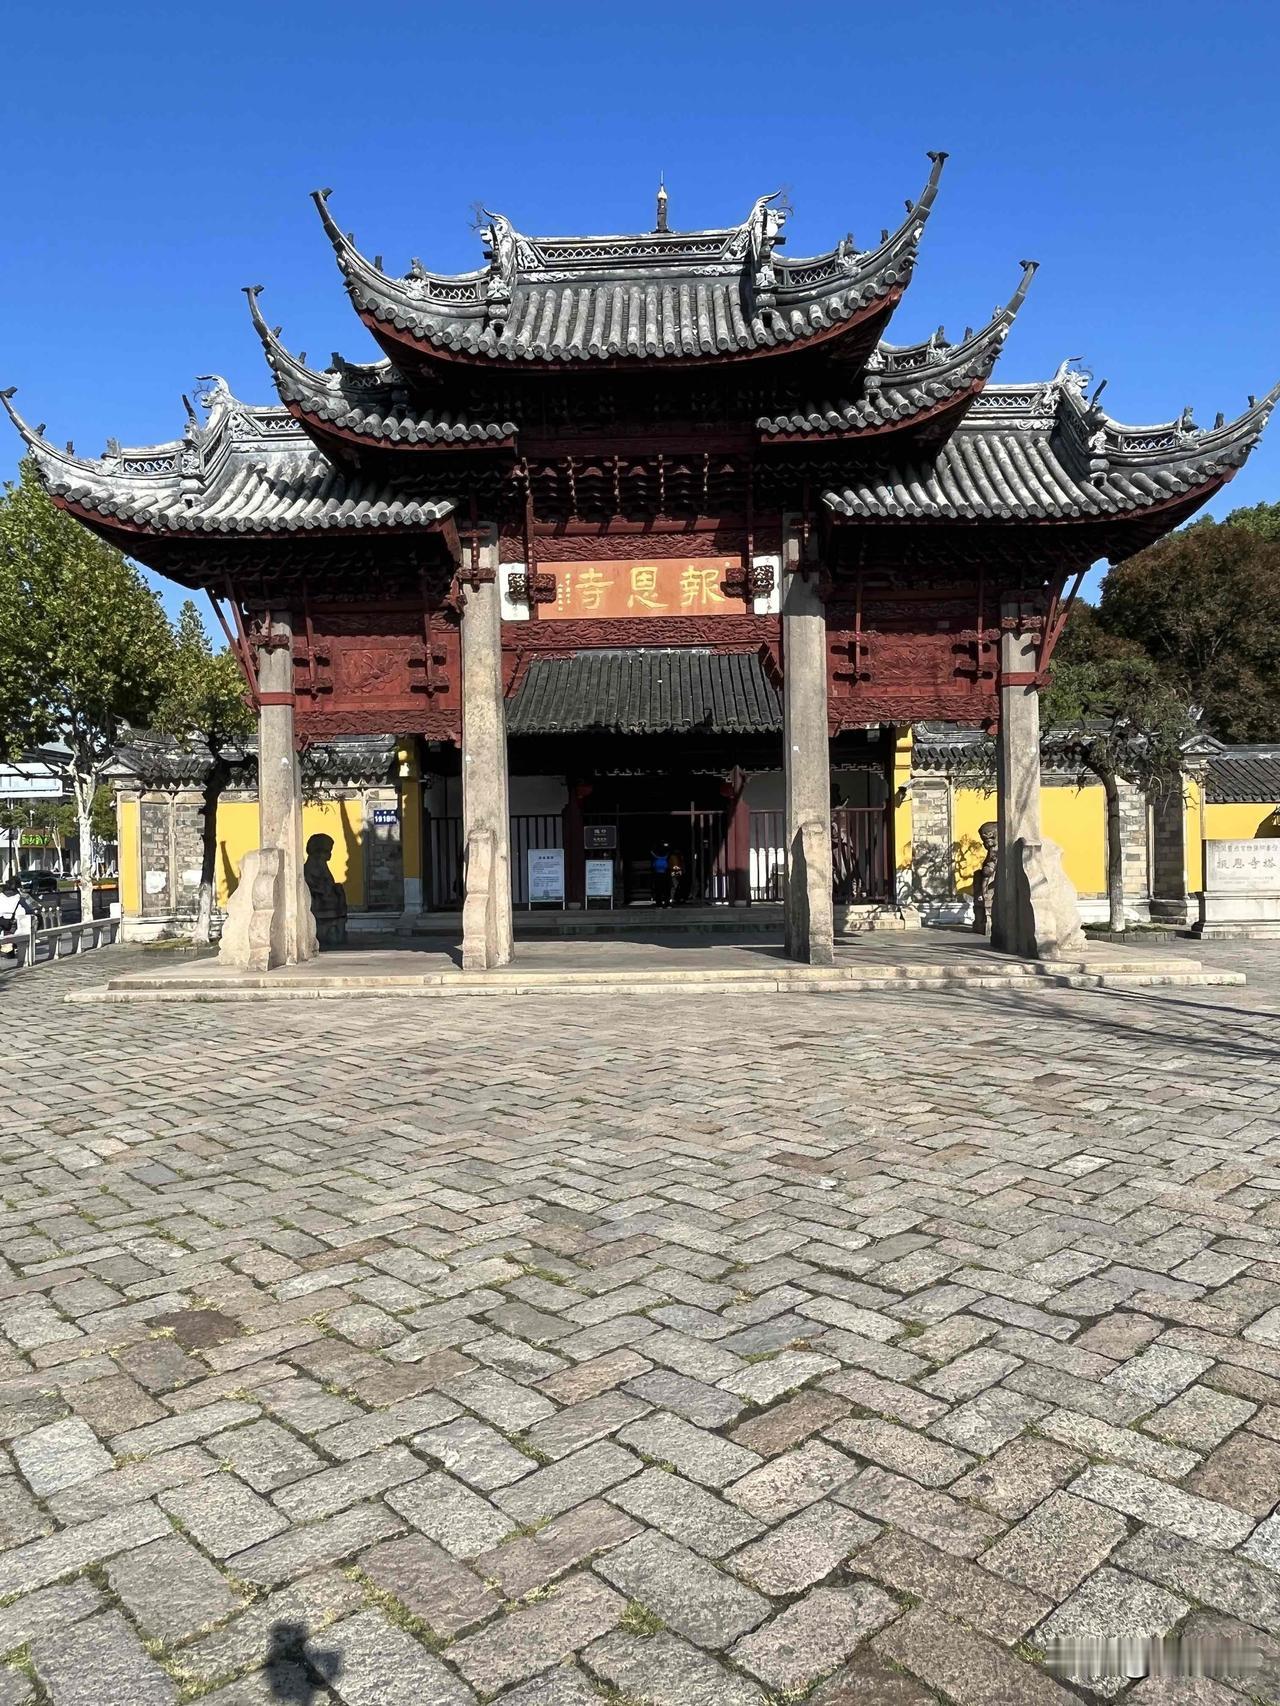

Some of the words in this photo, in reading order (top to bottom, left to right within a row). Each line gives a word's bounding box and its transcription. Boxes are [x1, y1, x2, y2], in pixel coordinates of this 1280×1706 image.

[574, 565, 726, 611] 報恩寺
[1217, 856, 1277, 869] 报恩寺塔
